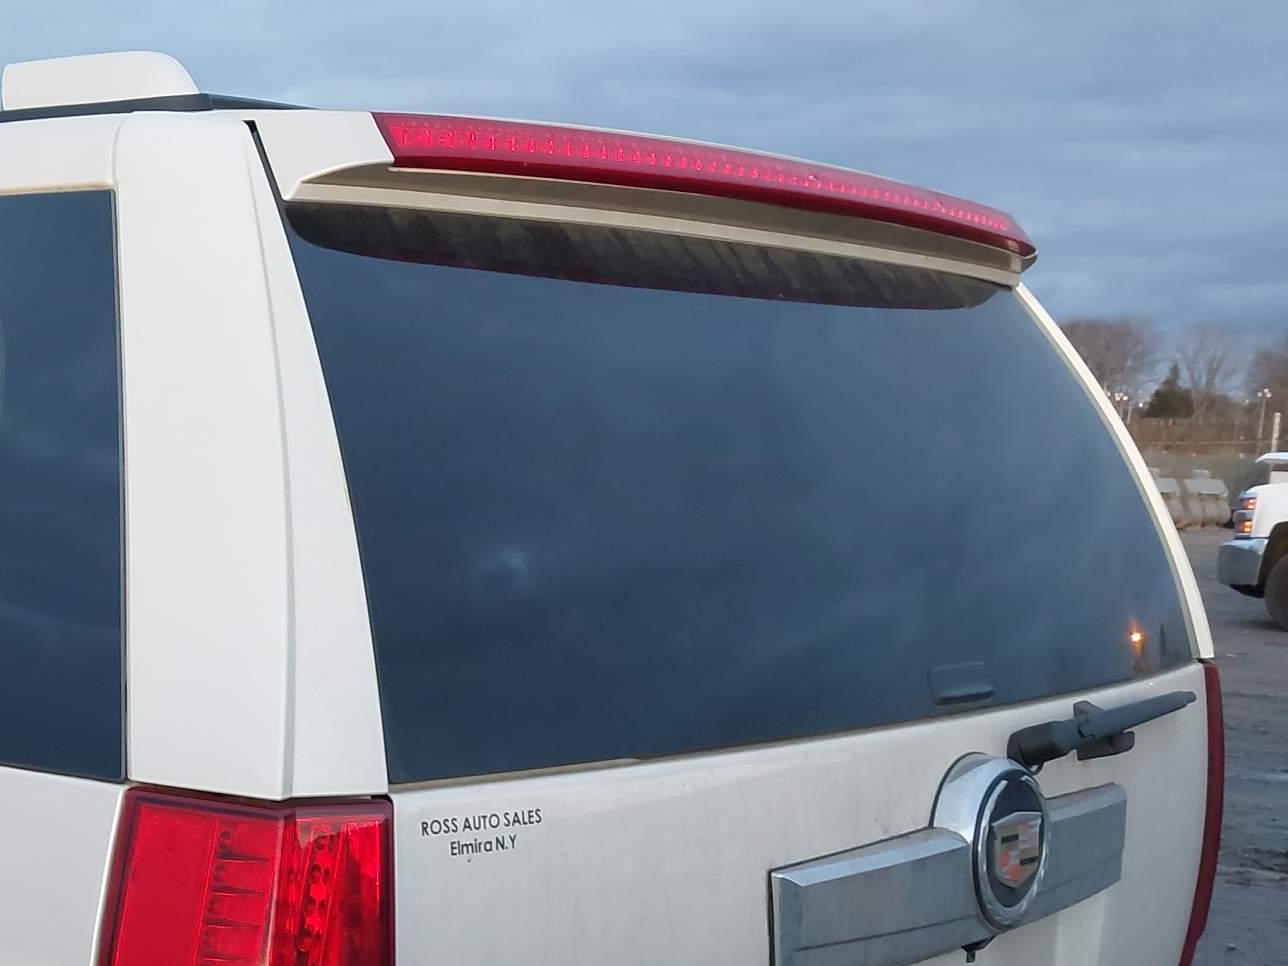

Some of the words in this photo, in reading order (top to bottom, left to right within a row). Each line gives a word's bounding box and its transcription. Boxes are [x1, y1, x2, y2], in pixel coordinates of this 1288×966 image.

[421, 817, 458, 837] ROSS
[462, 813, 500, 832] AUTO
[503, 808, 542, 827] SALES
[450, 838, 493, 856] Elmira
